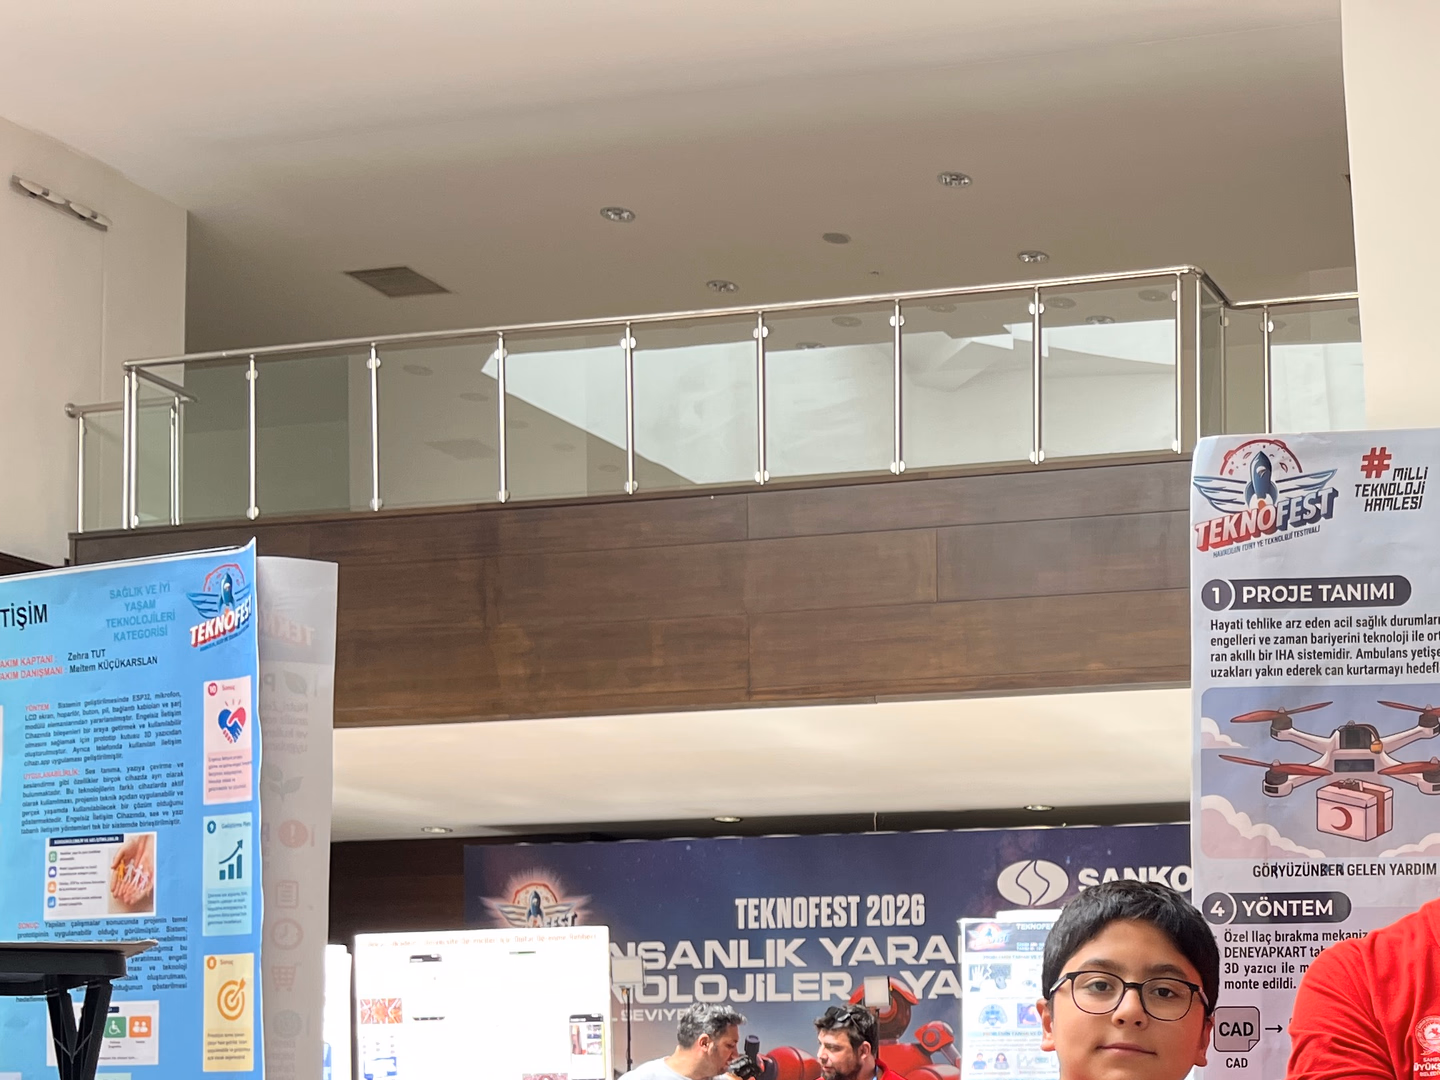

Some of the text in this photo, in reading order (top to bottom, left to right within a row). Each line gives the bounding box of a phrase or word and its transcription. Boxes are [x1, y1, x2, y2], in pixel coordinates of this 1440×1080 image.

[1194, 486, 1339, 552] TEKNOFEST
[110, 587, 147, 598] SAĞLIK
[149, 586, 158, 595] VE
[1212, 583, 1395, 605] 1 PROJE TANIMI
[124, 599, 156, 612] YAŞAM
[106, 611, 175, 628] TEKNOLOJİLERİ
[1211, 619, 1243, 633] Hayati
[1246, 617, 1282, 629] tehlike
[1285, 620, 1301, 629] arz
[1305, 617, 1331, 629] eden
[1334, 616, 1352, 628] acil
[1356, 615, 1387, 630] sağlık
[1210, 633, 1255, 649] engelleri
[1259, 636, 1271, 645] ve
[1273, 635, 1308, 645] zaman
[1311, 631, 1360, 648] bariyerini
[1363, 630, 1409, 646] teknoloji
[1412, 630, 1424, 642] ile
[91, 649, 106, 659] TUT
[1347, 863, 1386, 876] GELEN
[1389, 862, 1437, 876] YARDIM
[735, 893, 926, 930] TEKNOFEST 2026
[1210, 896, 1333, 917] 4 YÖNTEM
[1224, 930, 1319, 943] Özel bırakma
[1224, 946, 1307, 959] DENEYAPKART
[1224, 961, 1295, 977] 3D yazıcı ile
[1224, 977, 1297, 990] monte edildi.
[1218, 1022, 1254, 1037] CAD
[1225, 1057, 1248, 1069] CAD
